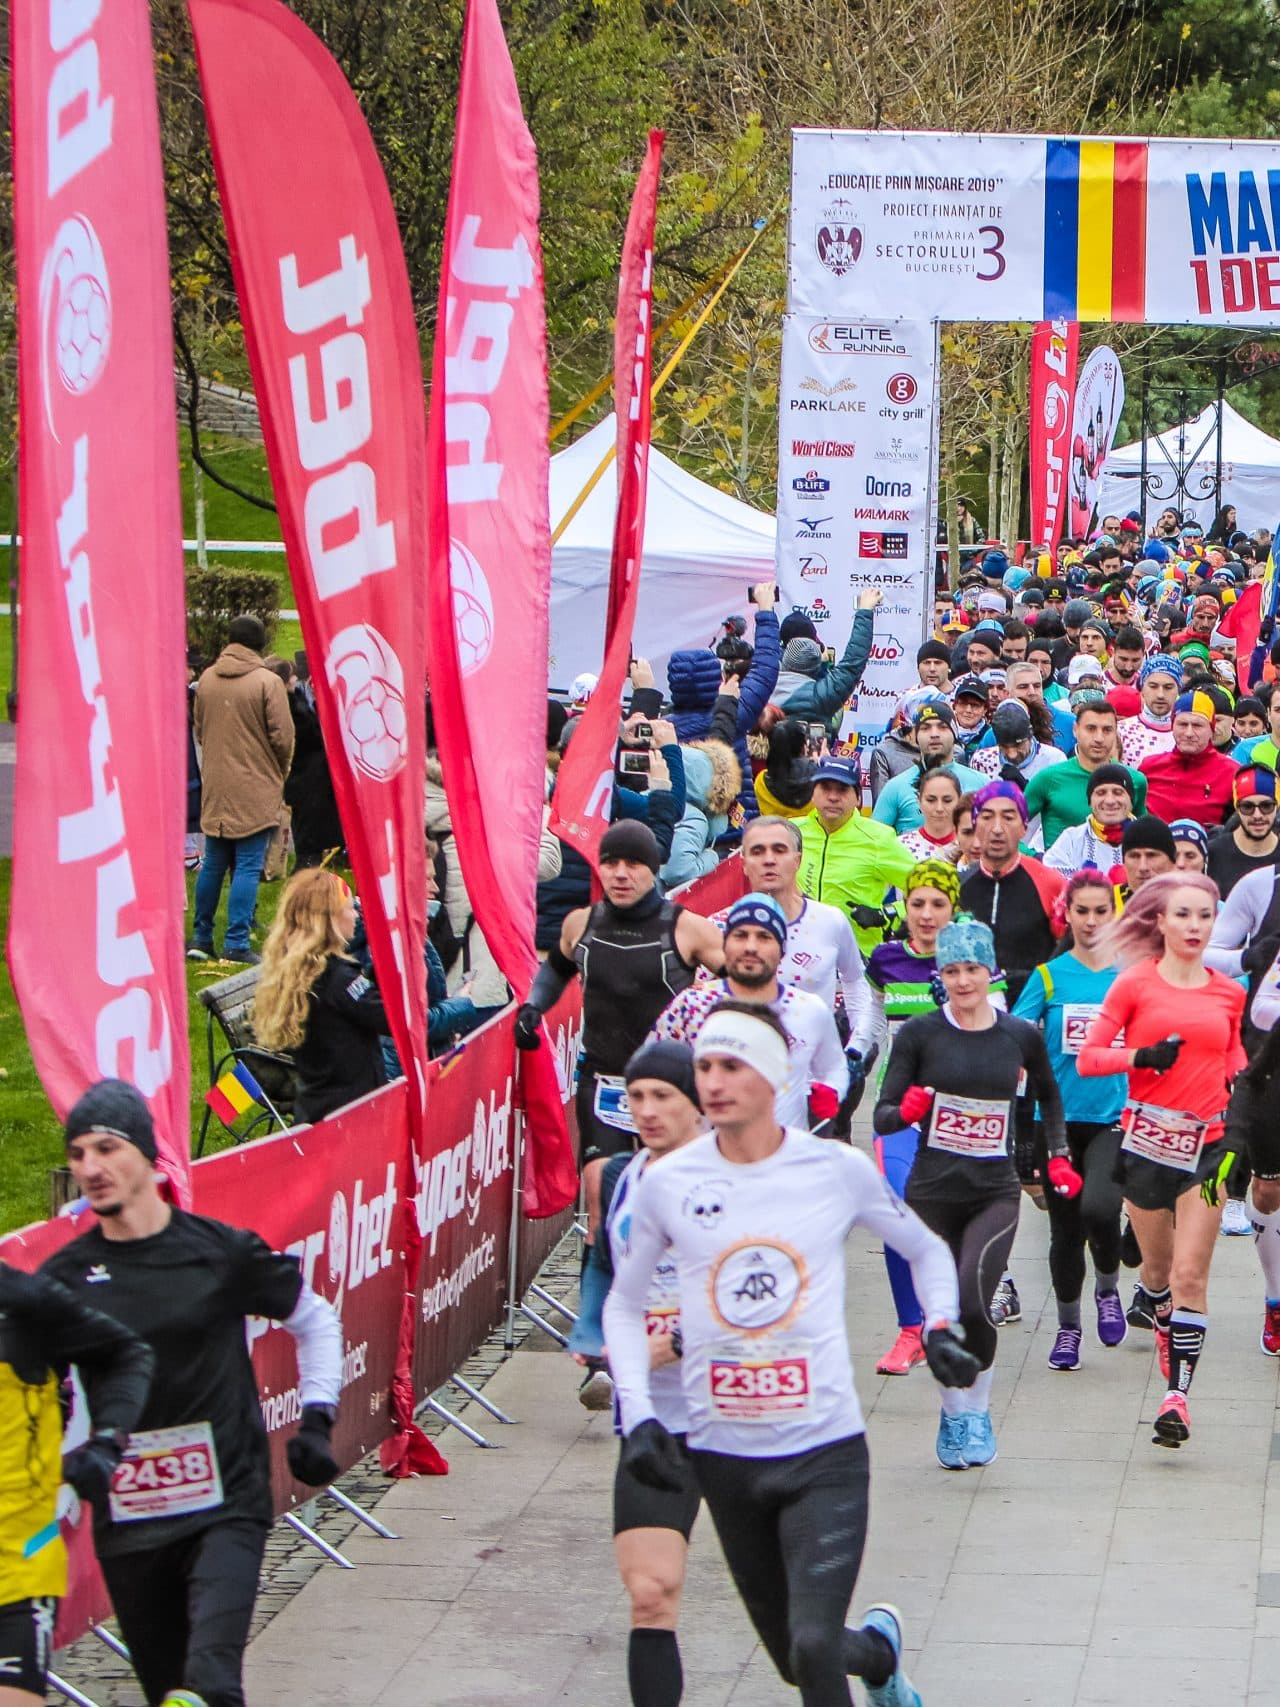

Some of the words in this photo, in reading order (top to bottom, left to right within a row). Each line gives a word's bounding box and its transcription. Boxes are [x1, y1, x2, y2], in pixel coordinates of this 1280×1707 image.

[885, 175, 911, 190] PRIN
[883, 203, 929, 217] PROIECT
[989, 206, 1003, 218] DE
[876, 245, 975, 259] SECTORULUI
[976, 225, 1006, 282] 3
[1189, 259, 1212, 315] 1
[834, 328, 893, 341] ELITE
[843, 343, 906, 354] RUNNING
[790, 400, 867, 412] PARKLAKE
[879, 407, 899, 420] city
[902, 408, 924, 420] grill
[792, 440, 826, 457] World
[825, 441, 856, 458] Class
[865, 475, 912, 497] Dorna
[854, 508, 911, 521] WALMARK
[873, 605, 912, 616] portier
[938, 1111, 1001, 1138] 2349
[1134, 1120, 1197, 1153] 2236
[348, 1162, 397, 1290] bet
[712, 1365, 805, 1397] 2383
[114, 1451, 211, 1492] 2438
